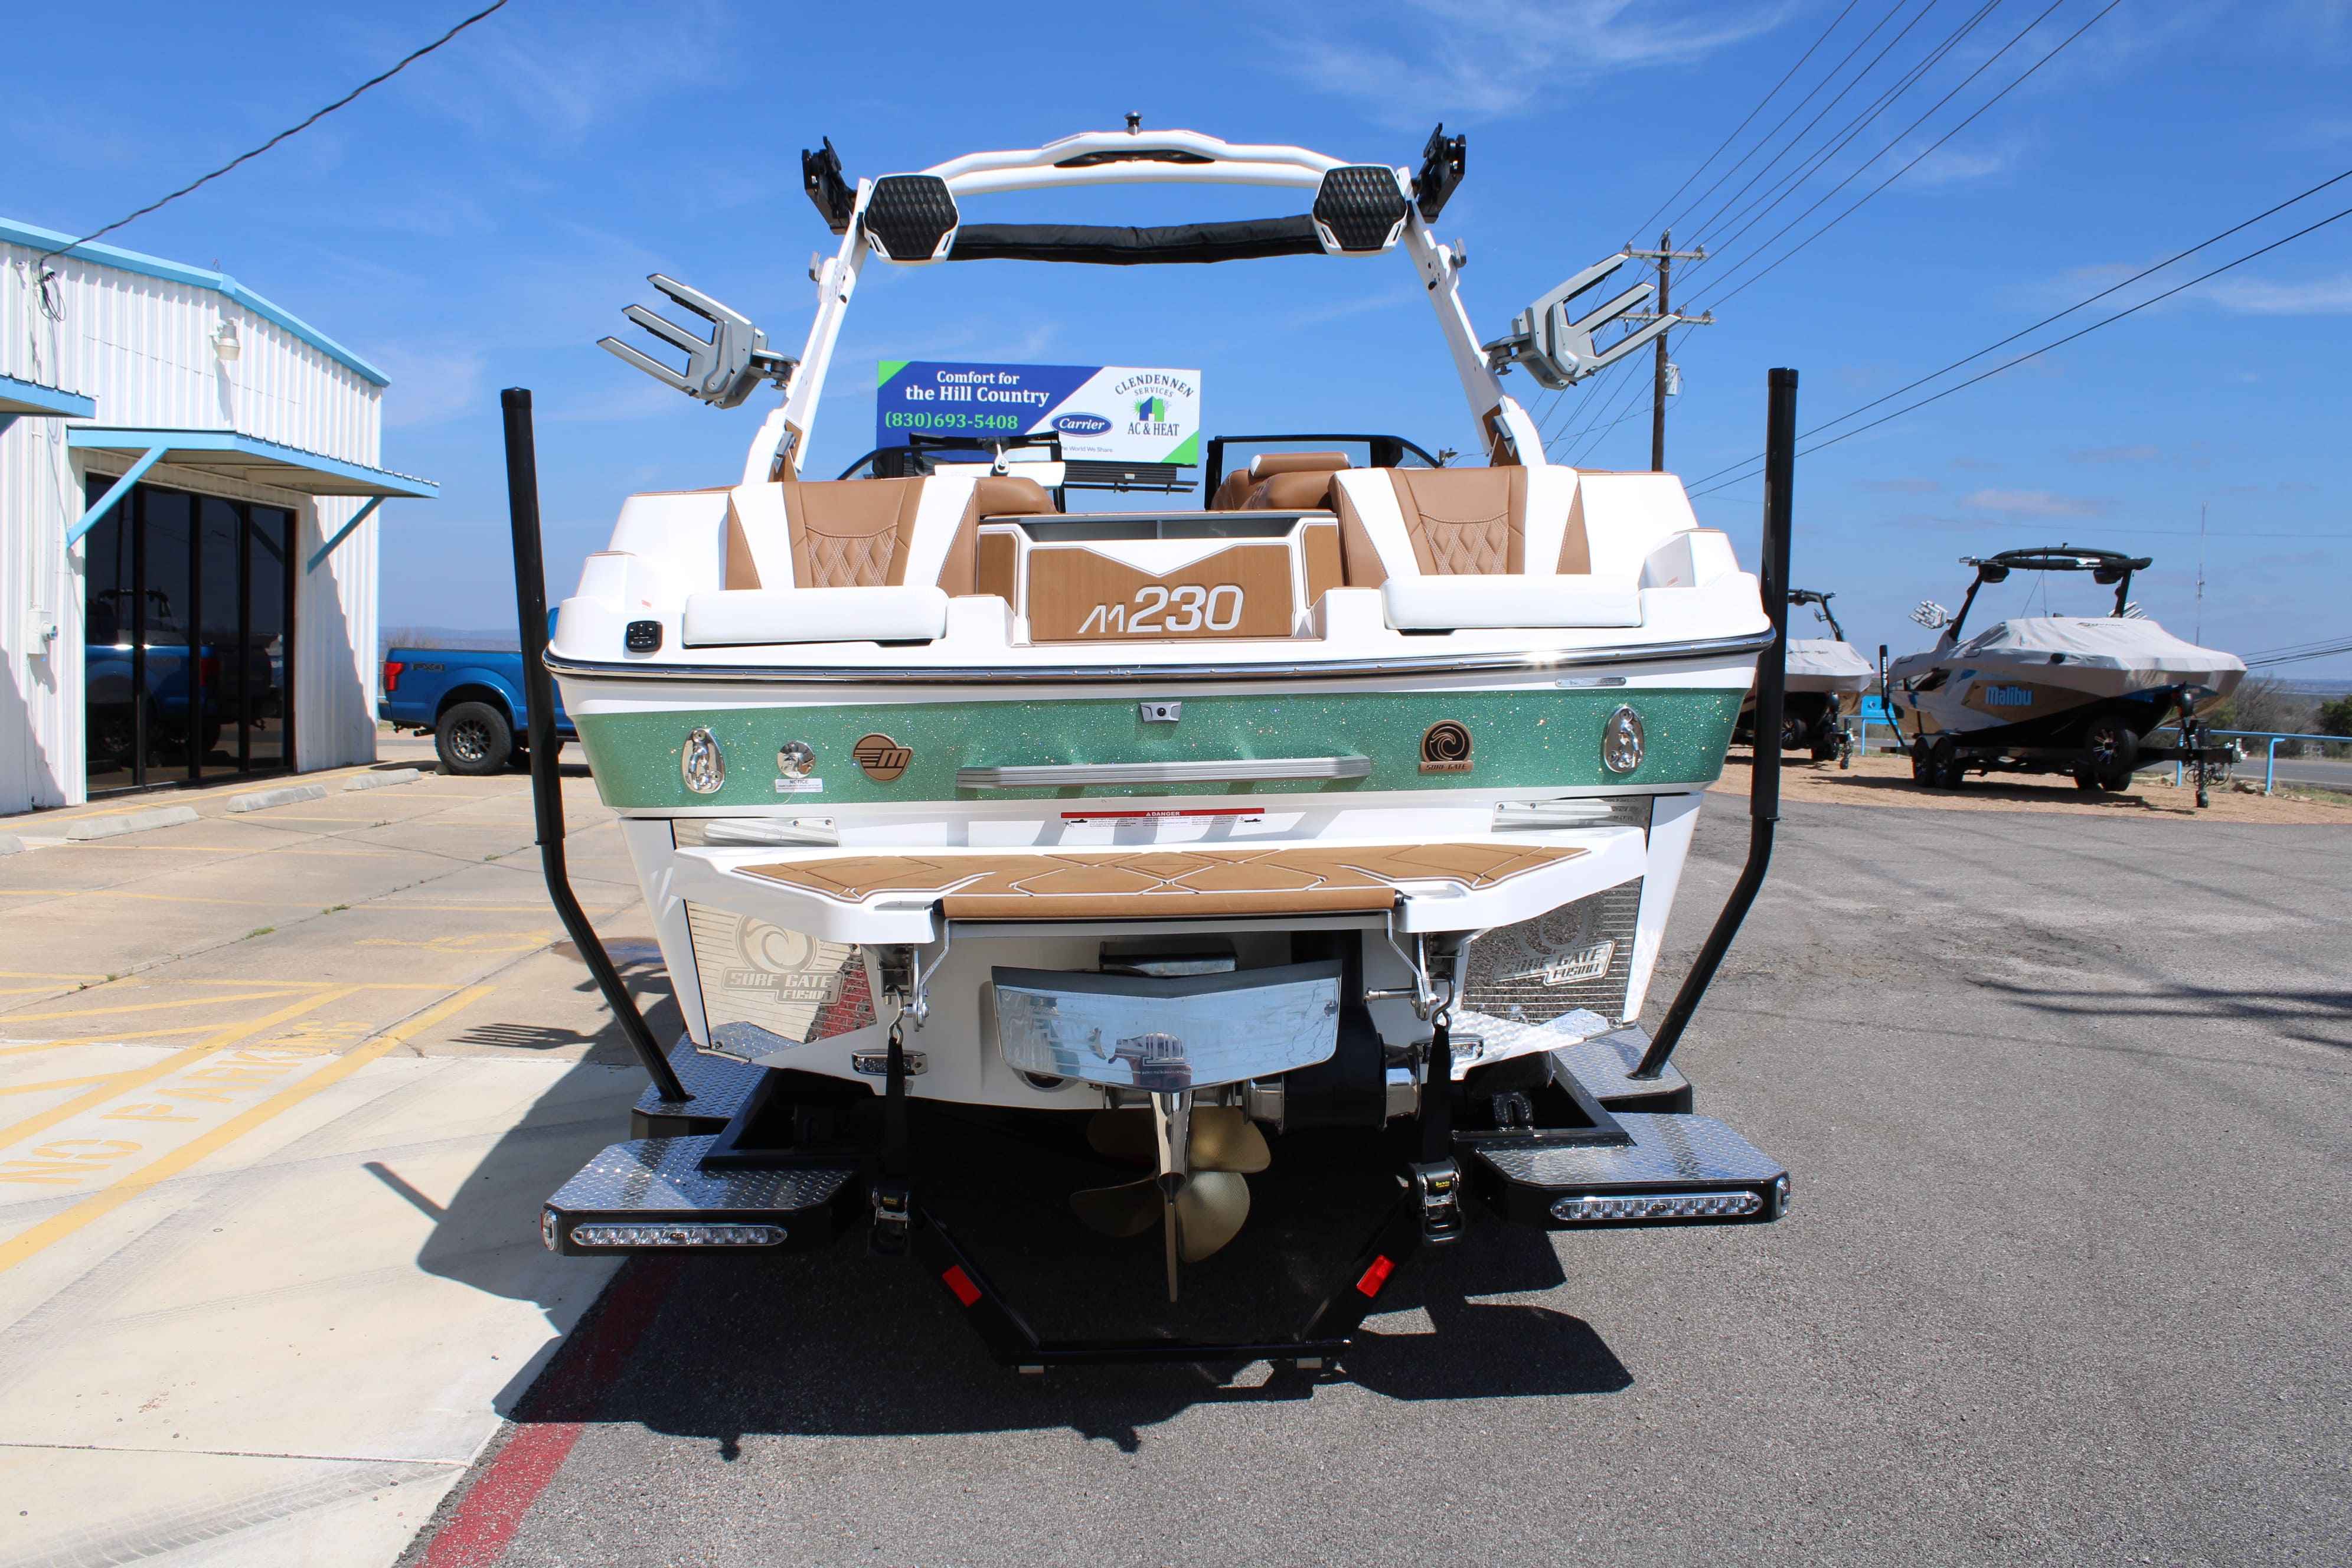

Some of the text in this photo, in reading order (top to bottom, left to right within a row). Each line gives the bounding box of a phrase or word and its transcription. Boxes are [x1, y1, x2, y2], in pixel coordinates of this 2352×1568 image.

[936, 371, 1020, 385] Comfort for
[1115, 374, 1194, 398] CLENDENNEN
[1134, 387, 1174, 397] SERVICES
[906, 385, 1050, 407] the Hill Country
[1059, 417, 1105, 431] Carrier
[1128, 422, 1180, 436] AC & HEAT
[411, 662, 445, 671] FX4
[1985, 686, 2032, 705] Malibu
[1557, 948, 1604, 966] GATE
[729, 972, 835, 988] SURF GATE
